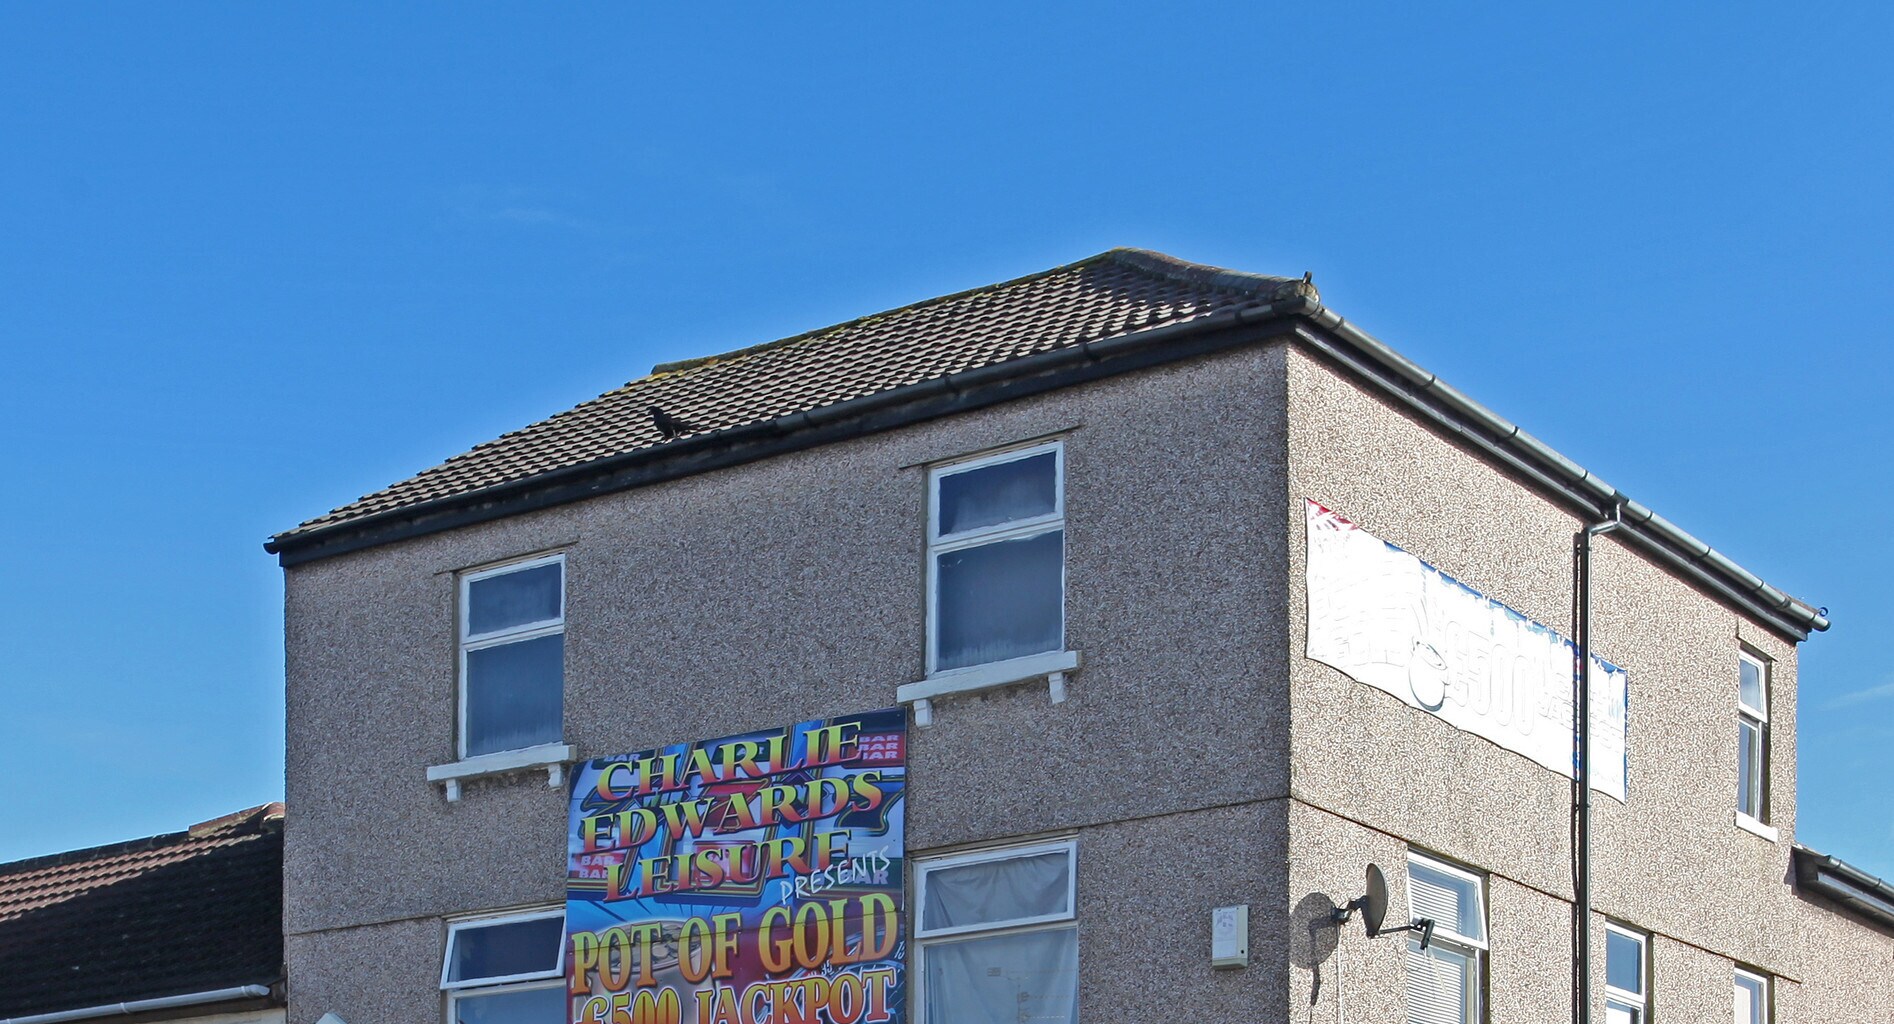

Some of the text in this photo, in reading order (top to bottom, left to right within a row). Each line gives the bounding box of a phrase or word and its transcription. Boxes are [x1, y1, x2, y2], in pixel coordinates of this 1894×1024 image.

[597, 721, 862, 801] CHARLIE
[580, 770, 884, 853] EDWARDS
[603, 829, 852, 902] LEISURE
[780, 845, 891, 902] PRESENTS
[571, 893, 898, 995] POT OF GOLD
